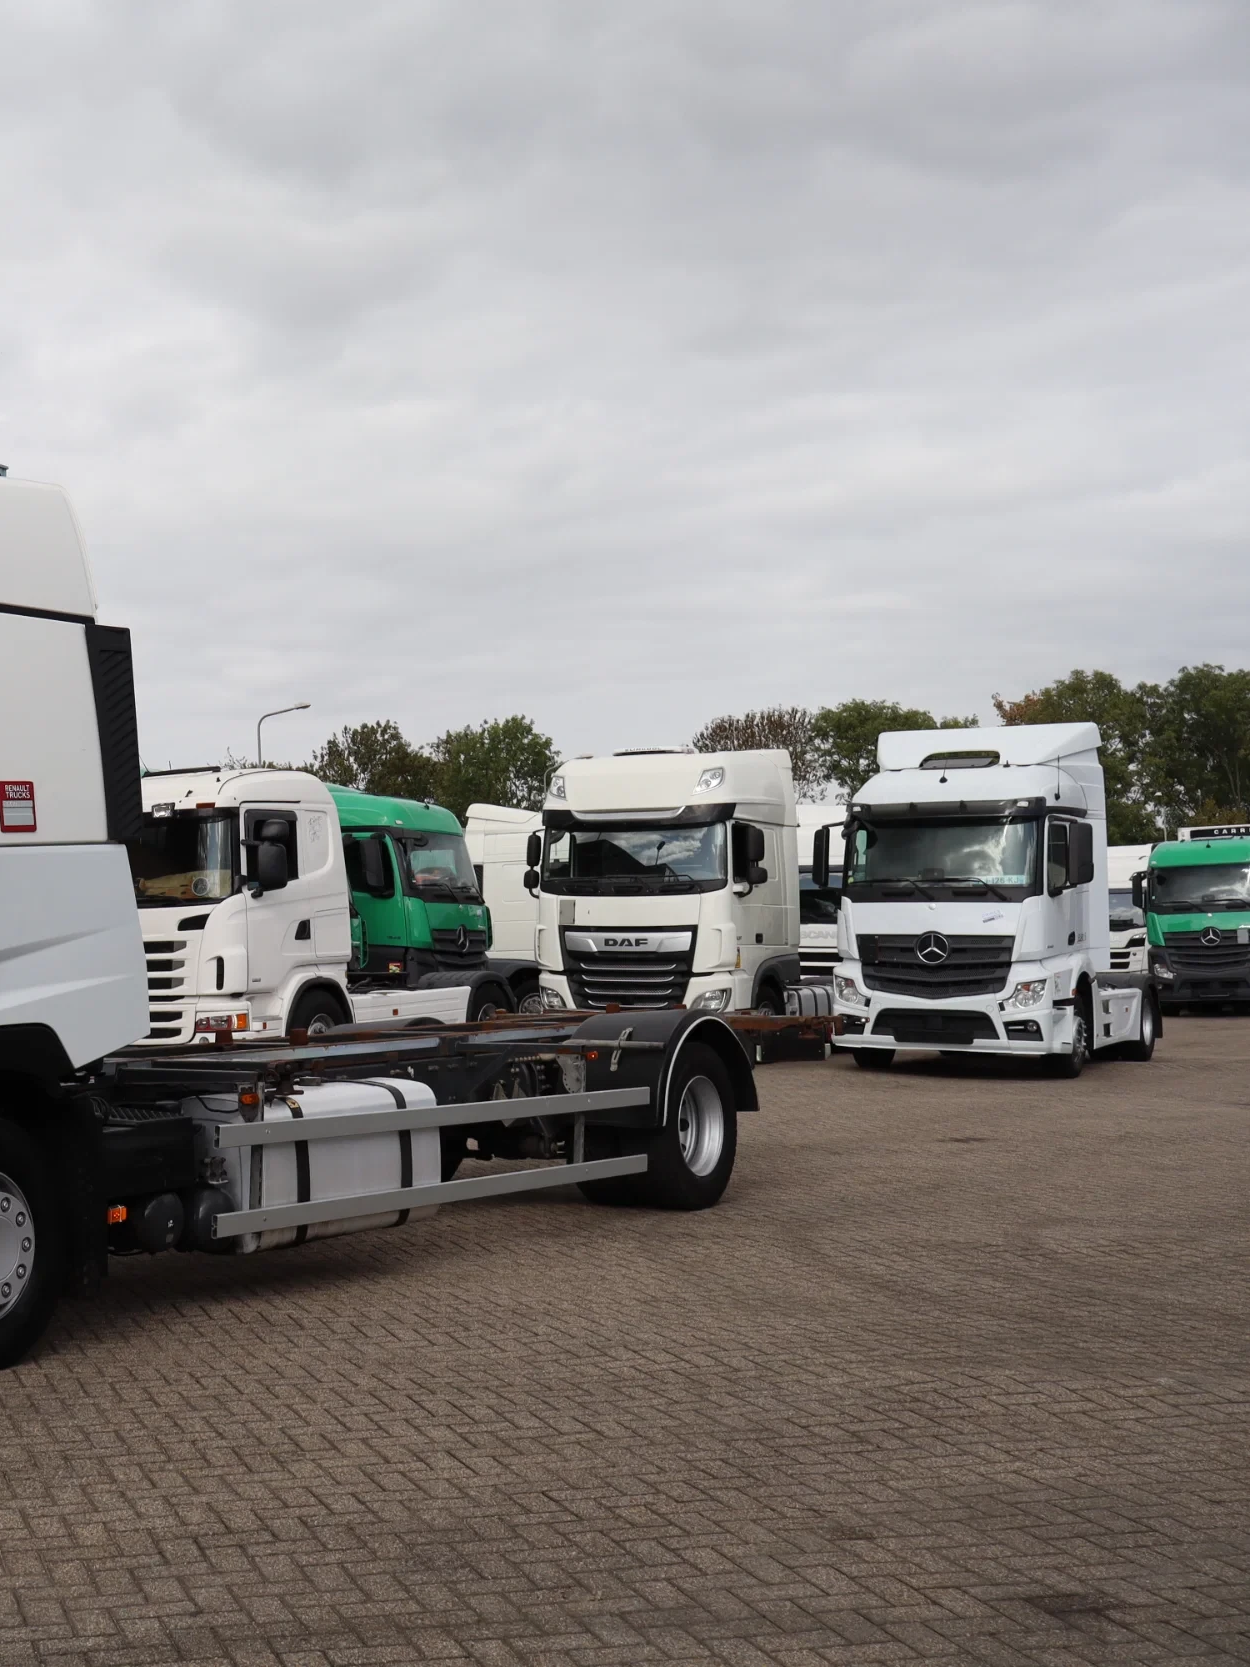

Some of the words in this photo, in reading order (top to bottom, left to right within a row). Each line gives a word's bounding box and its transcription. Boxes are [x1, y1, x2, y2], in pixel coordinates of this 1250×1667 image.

[4, 784, 30, 792] RENAULT
[5, 791, 31, 799] TRUCKS
[1213, 827, 1250, 835] CARR
[800, 929, 838, 940] SCAN
[603, 938, 649, 947] DAF
